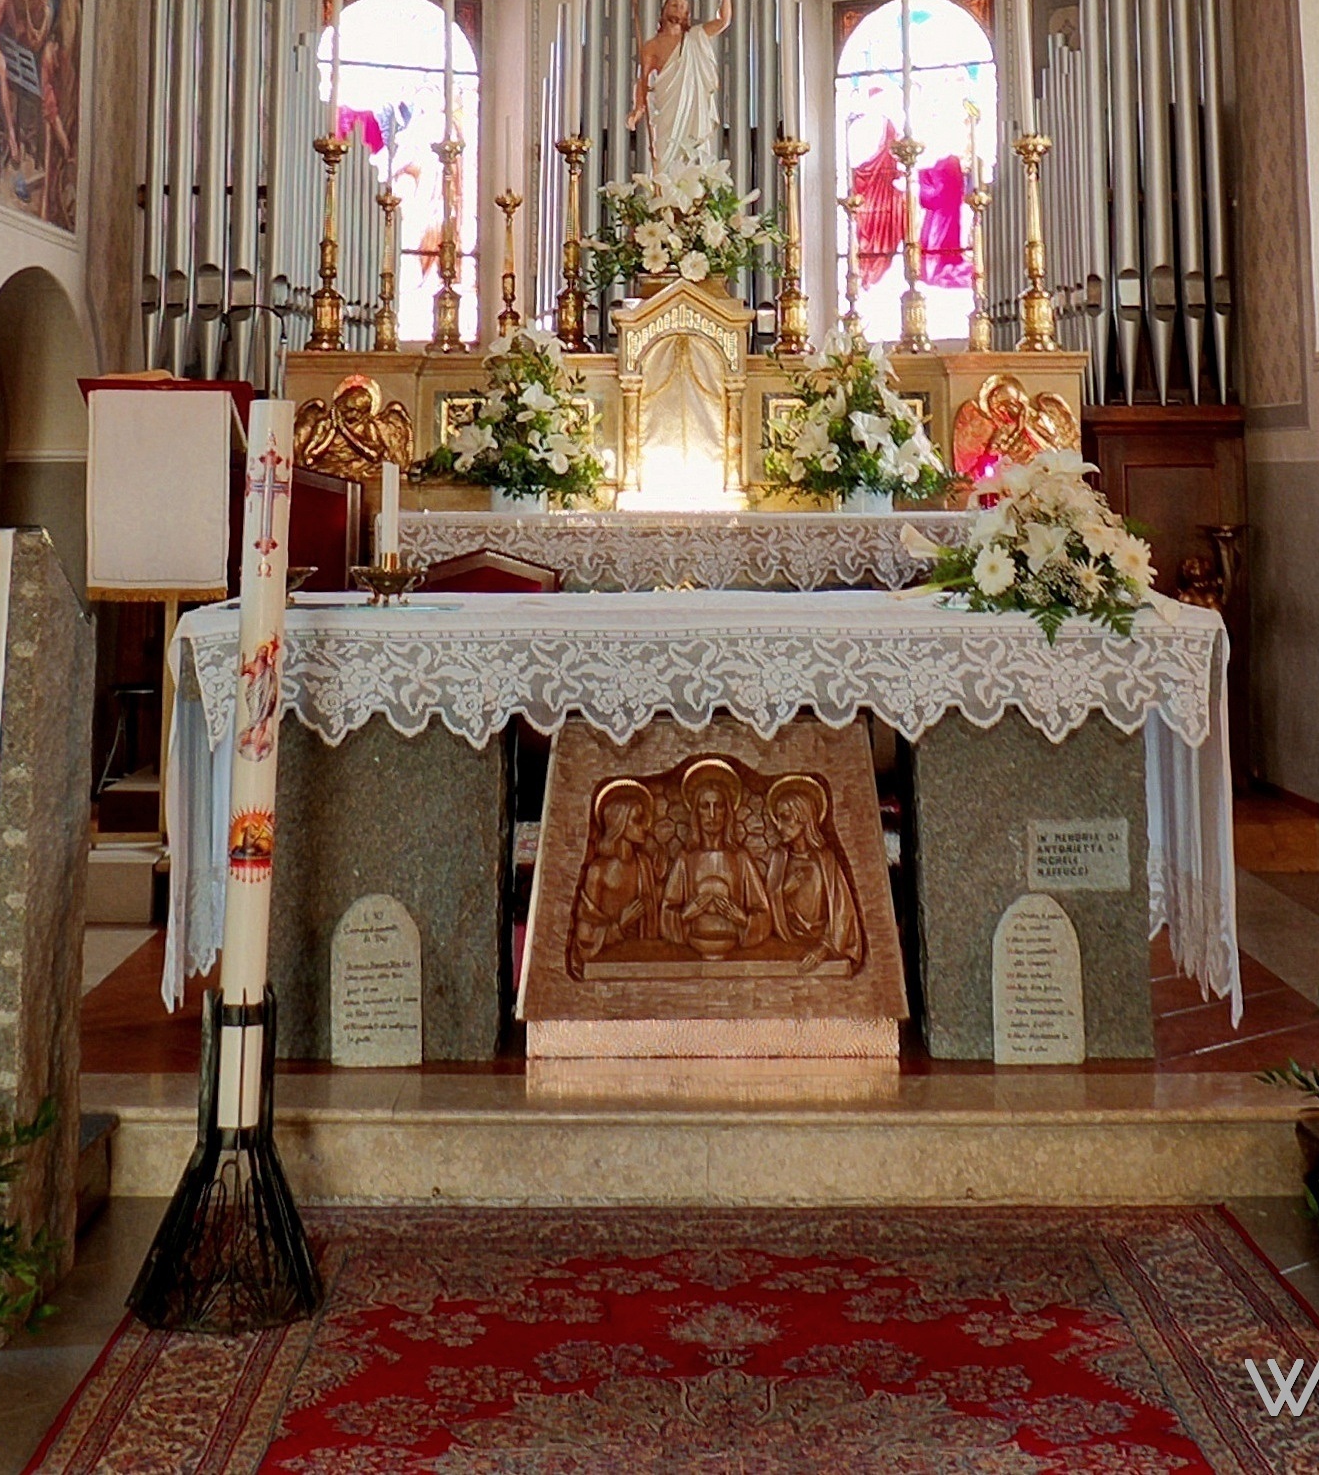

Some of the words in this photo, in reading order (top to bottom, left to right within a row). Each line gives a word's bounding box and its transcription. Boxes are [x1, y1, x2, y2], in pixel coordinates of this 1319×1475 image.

[1054, 832, 1100, 843] MEMORIA
[1036, 843, 1104, 854] ANTONIETTA
[1036, 855, 1079, 866] MICHELE
